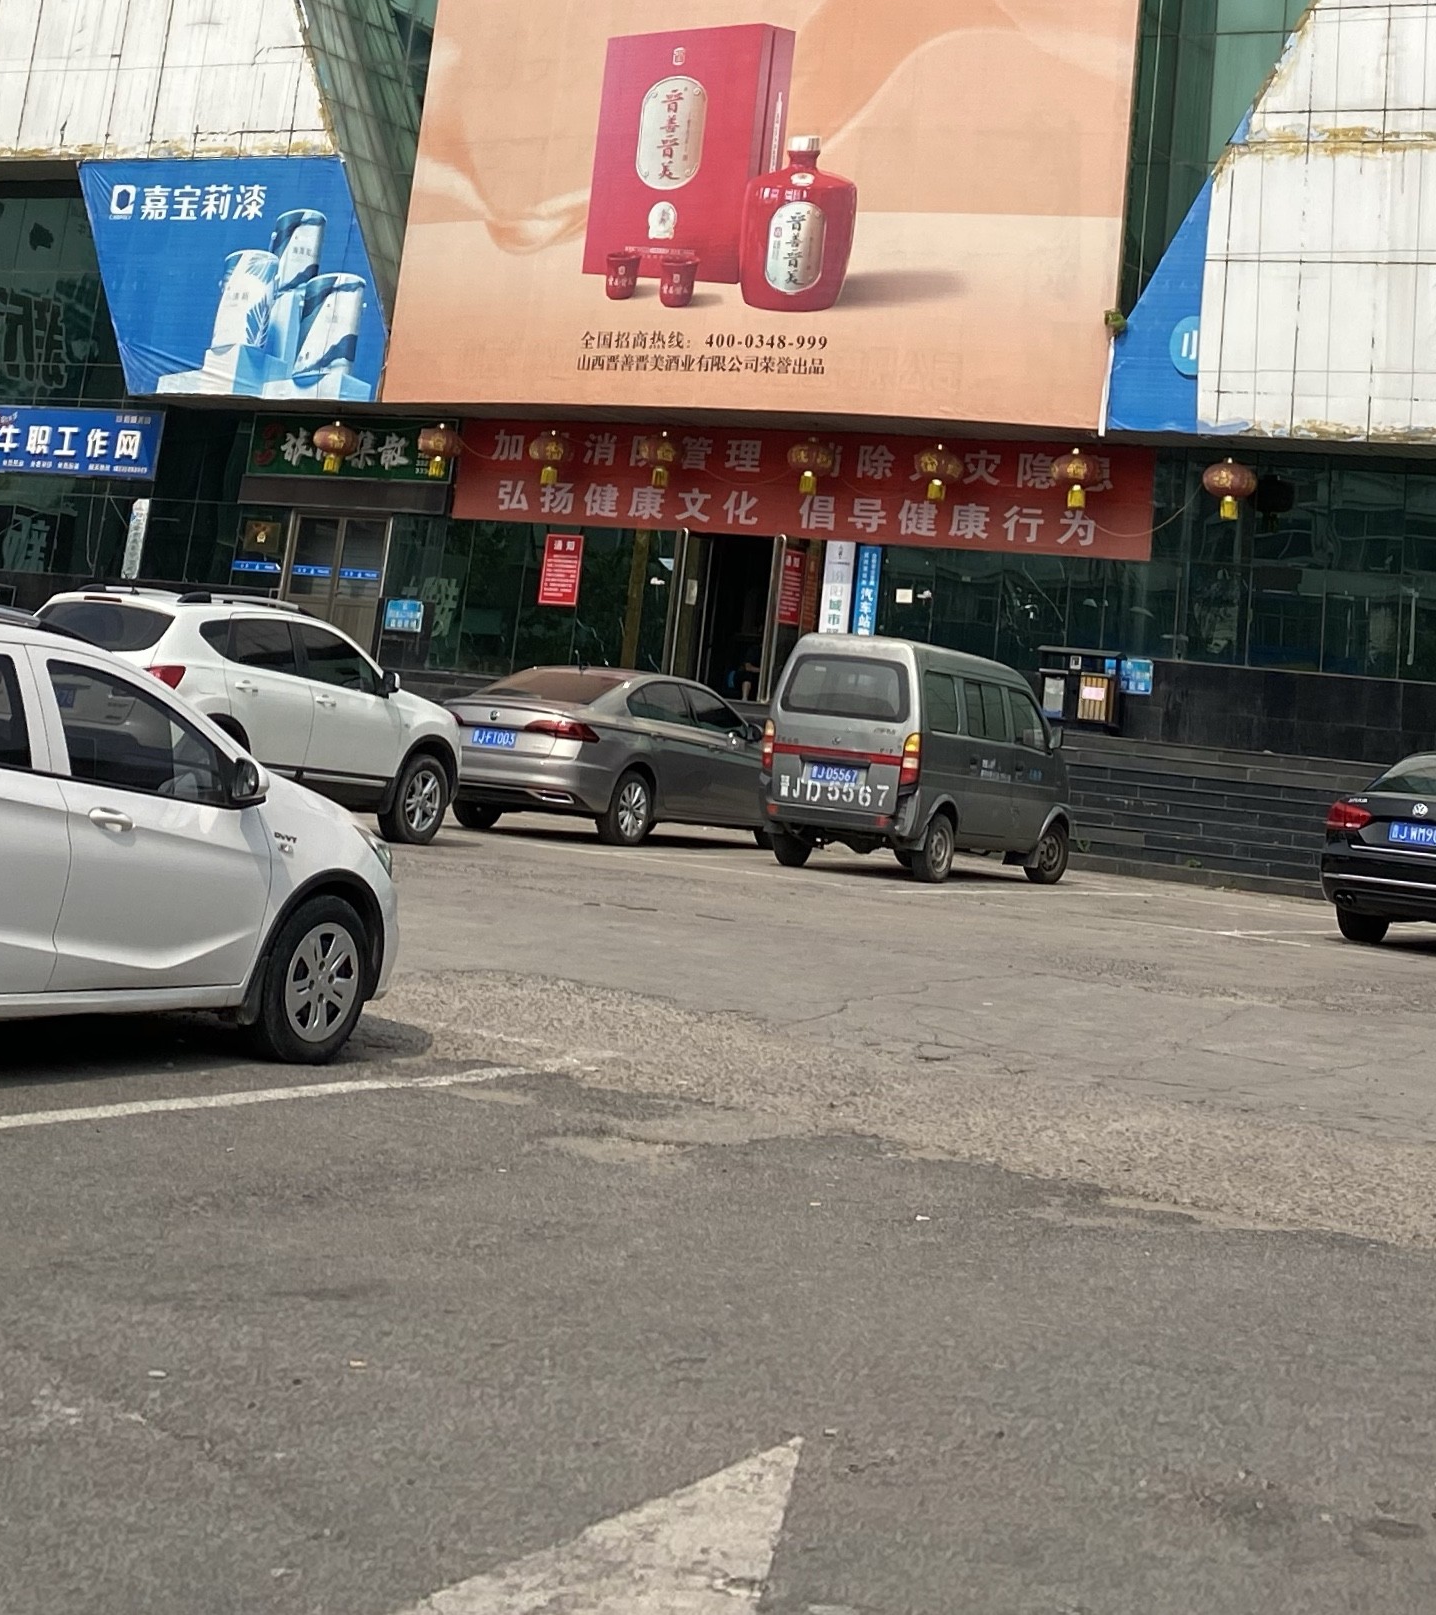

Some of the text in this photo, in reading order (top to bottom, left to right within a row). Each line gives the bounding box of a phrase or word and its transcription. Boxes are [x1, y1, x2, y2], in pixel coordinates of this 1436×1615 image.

[140, 184, 268, 221] 嘉宝莉漆
[580, 330, 828, 351] 全国招商热线： 400-0348-999
[577, 353, 826, 375] 山西晋善晋美酒业有限公司荣誉出品
[280, 426, 411, 471] 旅集散
[492, 429, 763, 473] 加消管理
[498, 479, 1097, 547] 弘扬健康文化 倡导健康行为
